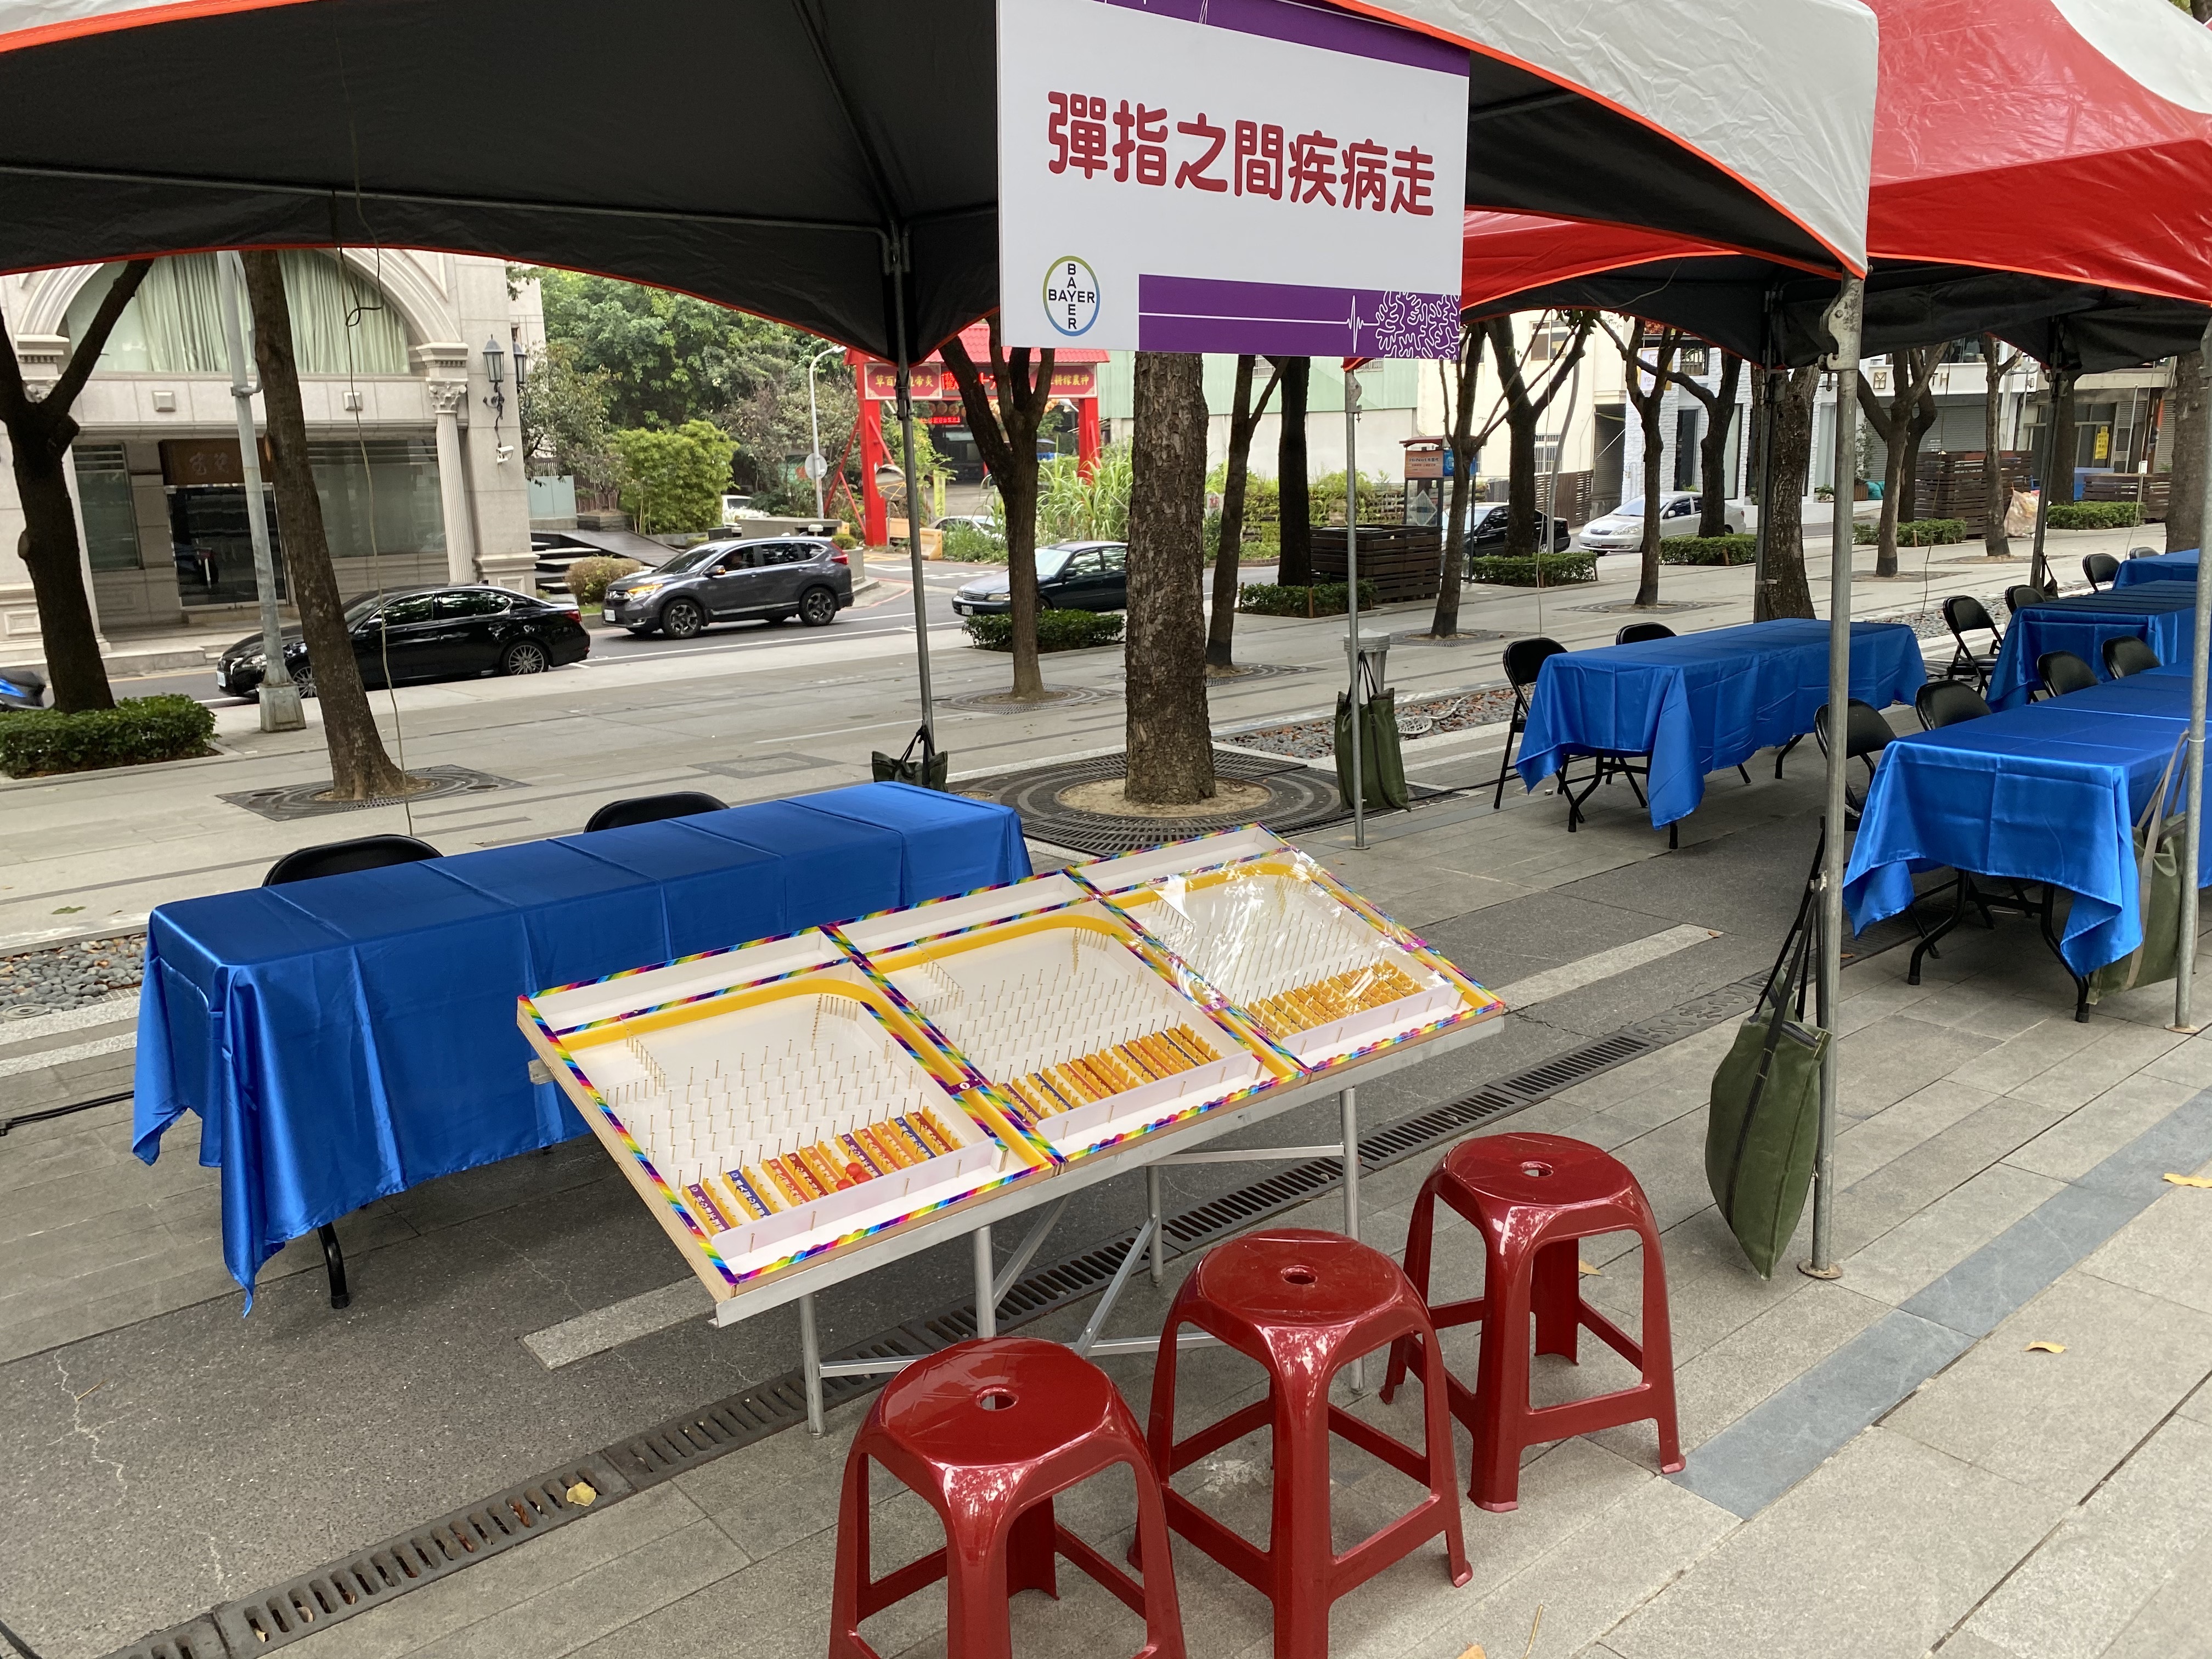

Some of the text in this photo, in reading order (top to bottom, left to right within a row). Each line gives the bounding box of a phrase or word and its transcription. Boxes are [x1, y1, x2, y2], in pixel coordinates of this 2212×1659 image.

[1048, 91, 1435, 216] 彈指之間疾病走
[1048, 289, 1095, 303] BAYER
[1067, 263, 1077, 329] BAYER
